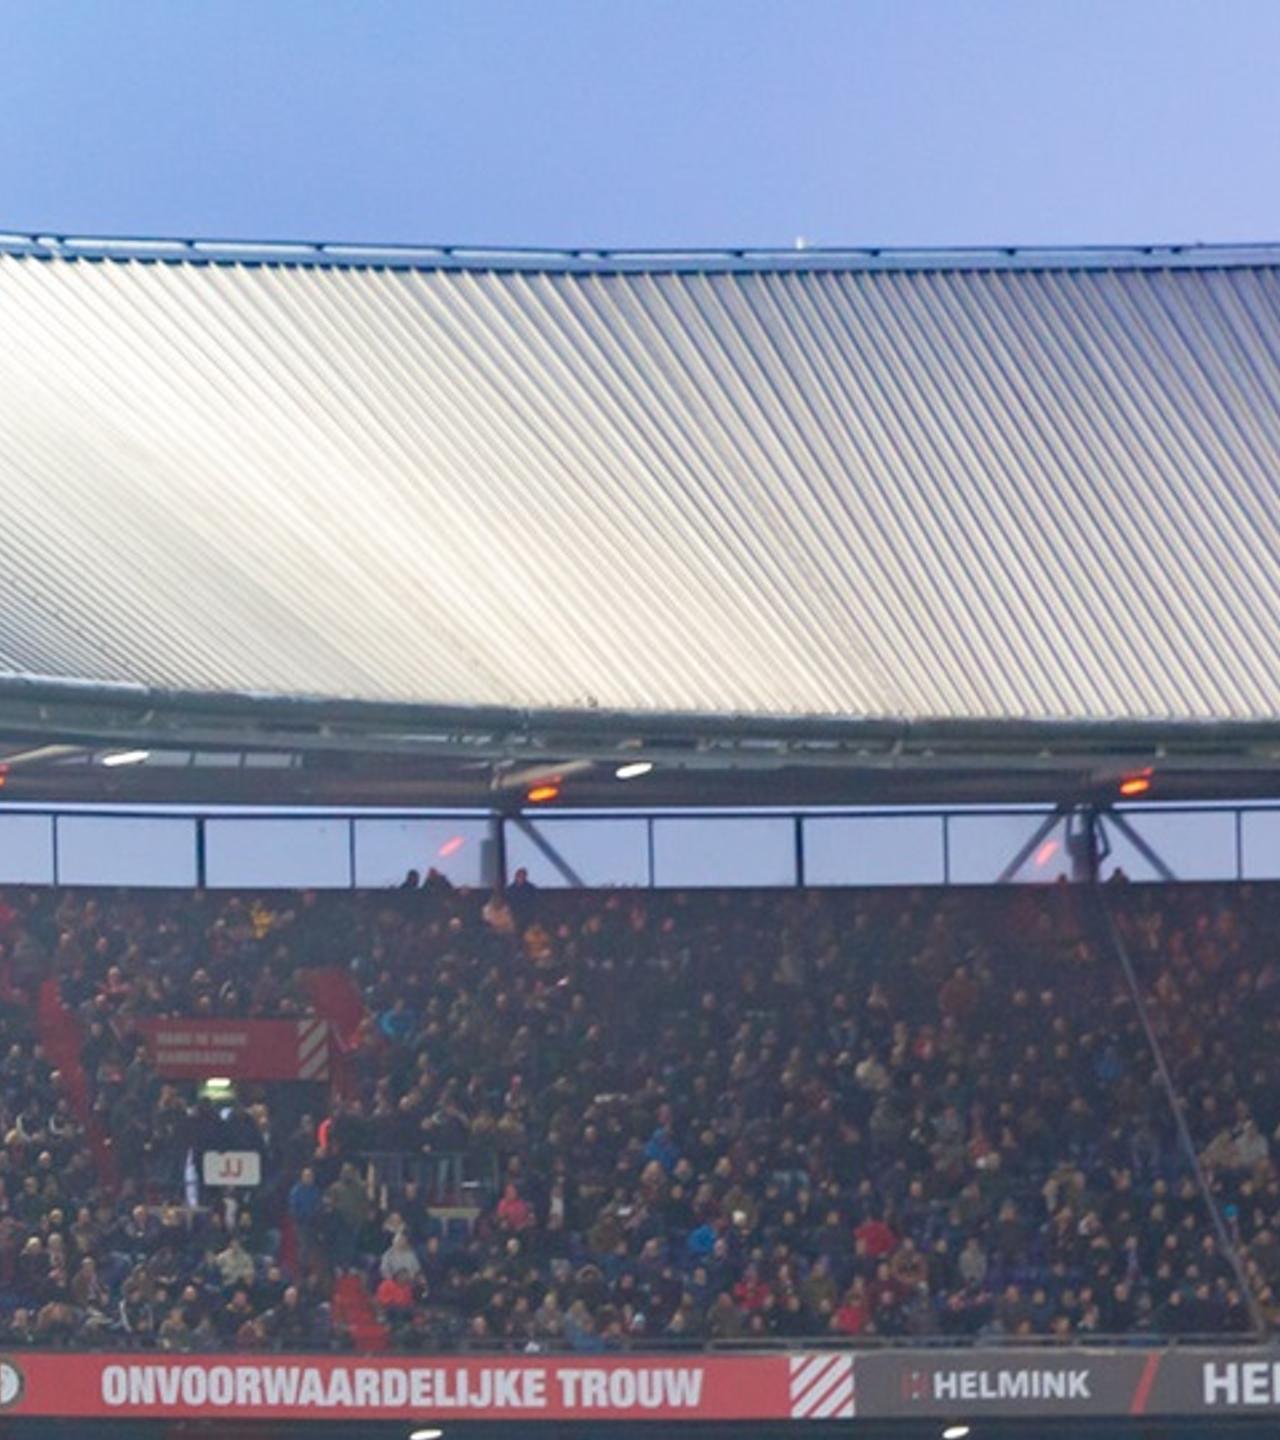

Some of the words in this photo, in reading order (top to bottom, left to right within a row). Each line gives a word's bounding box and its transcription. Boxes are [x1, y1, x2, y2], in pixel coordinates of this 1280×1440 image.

[222, 1161, 243, 1178] JJ
[101, 1364, 547, 1408] ONVOORWAARDELIJKE
[557, 1368, 704, 1408] TROUW
[933, 1369, 1092, 1399] HELMINK
